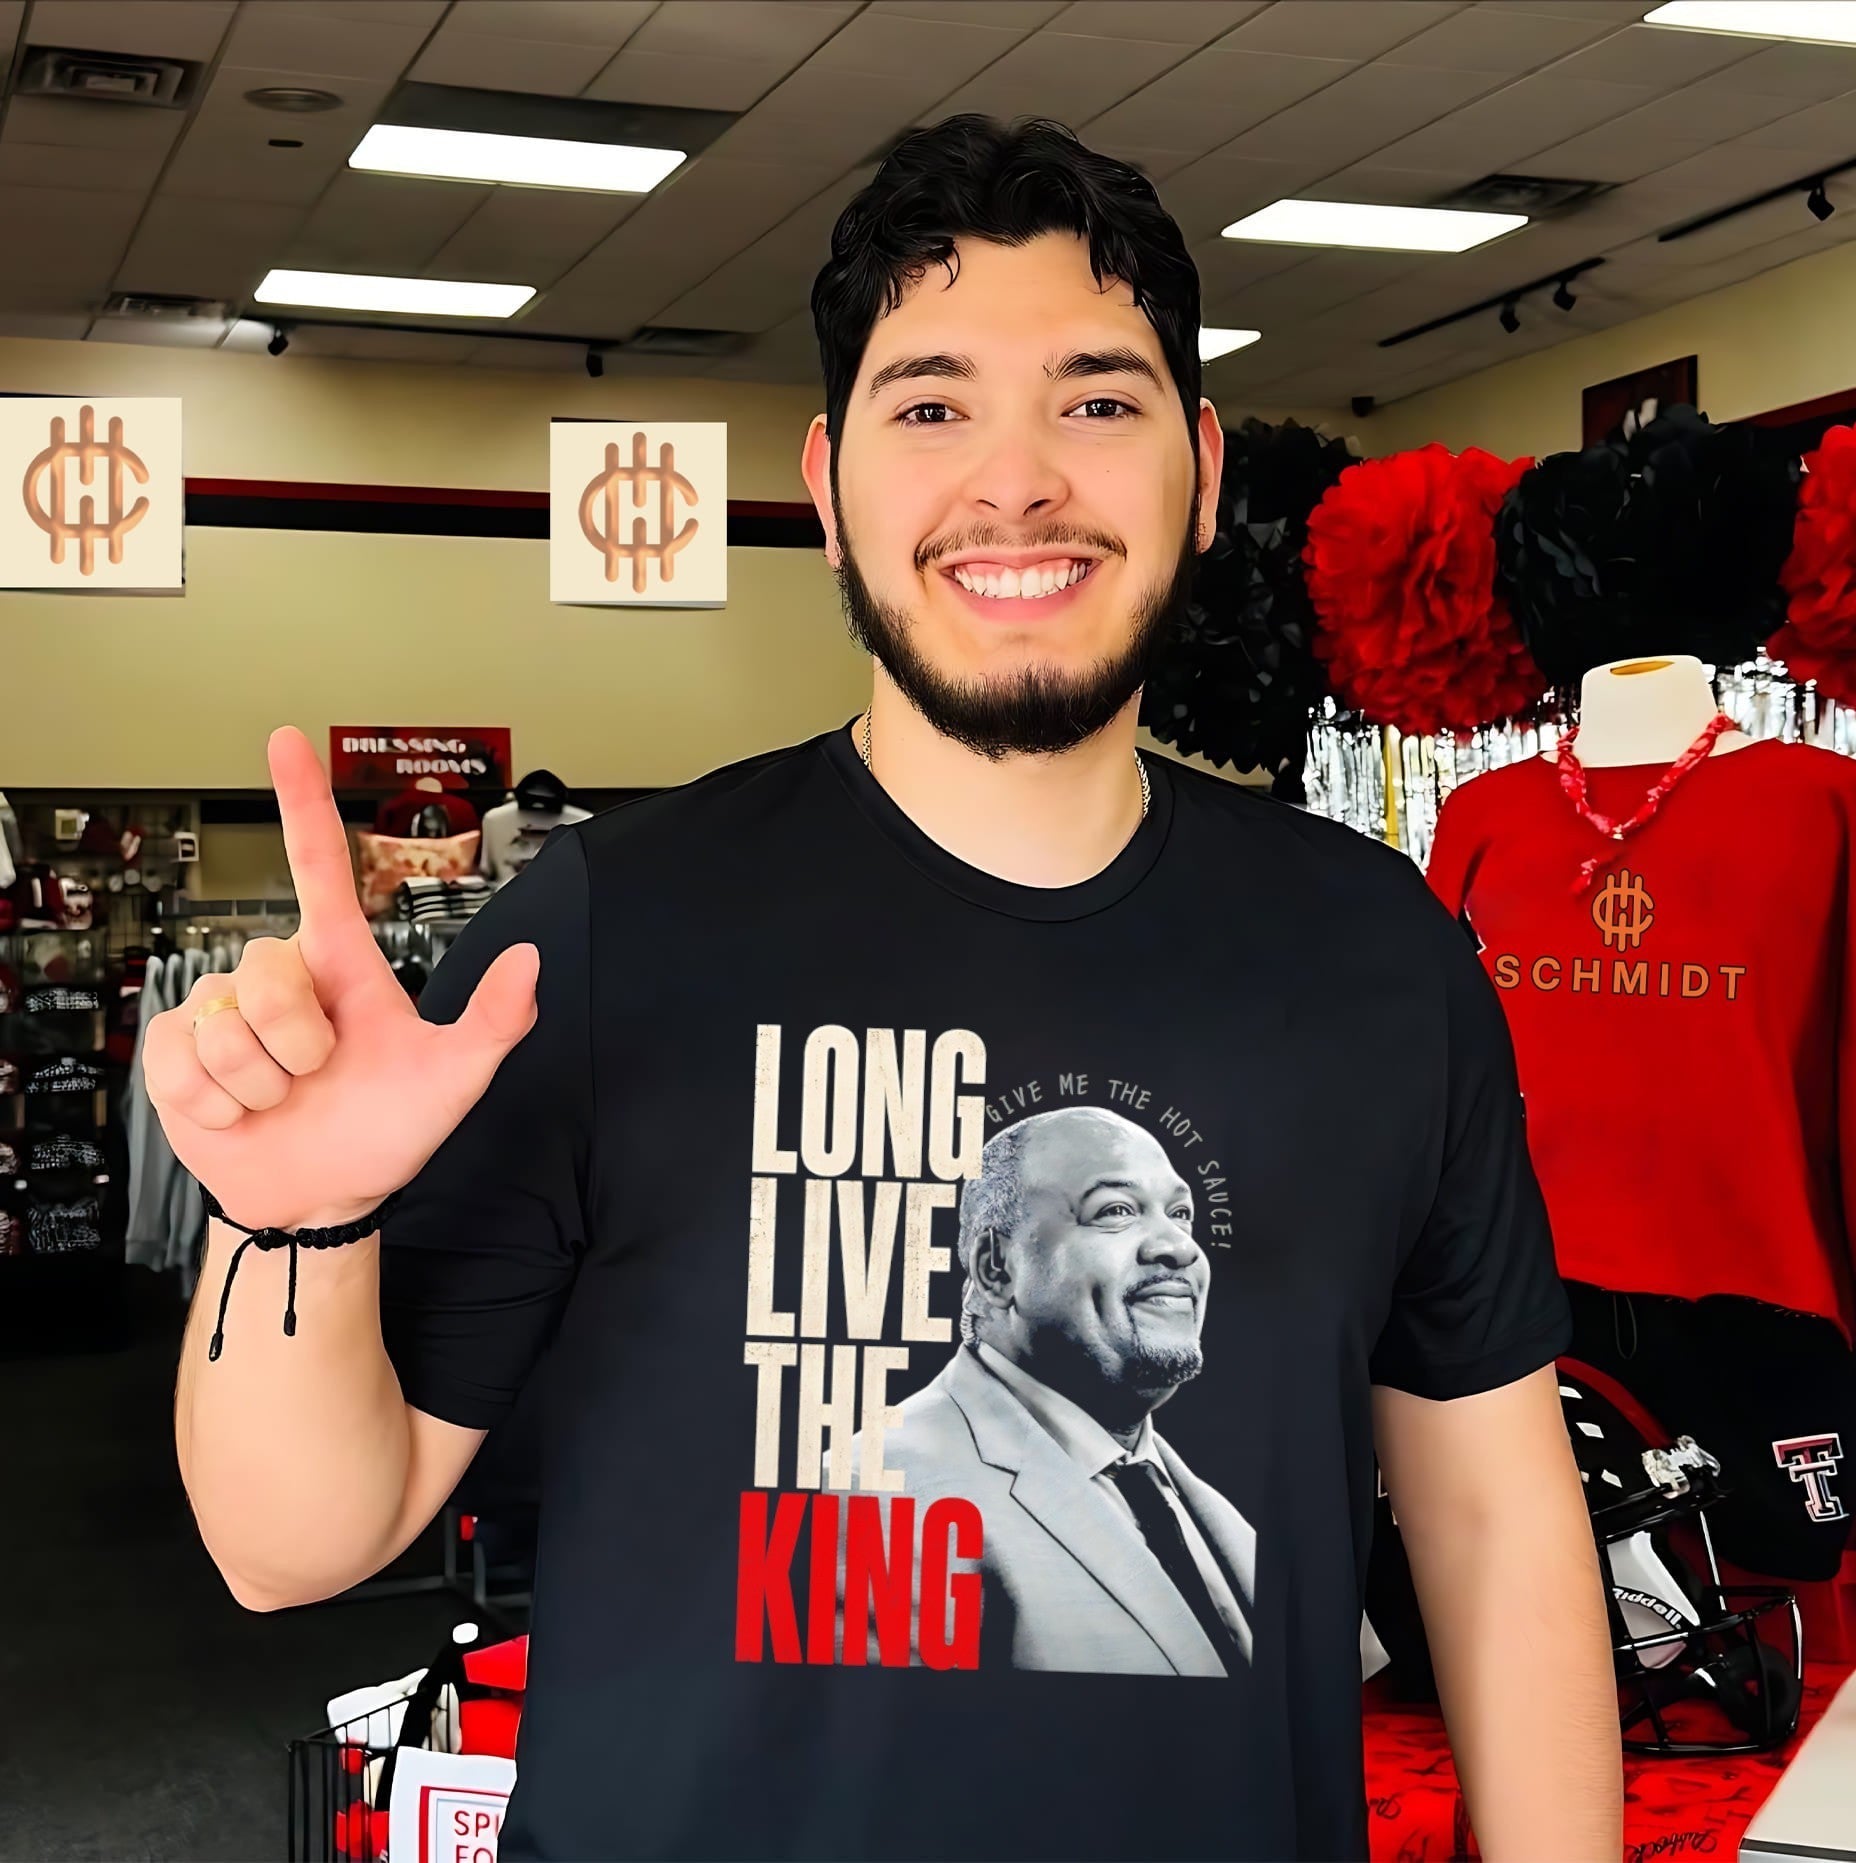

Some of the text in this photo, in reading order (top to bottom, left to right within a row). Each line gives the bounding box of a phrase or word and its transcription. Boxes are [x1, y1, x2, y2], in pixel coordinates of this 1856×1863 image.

[342, 738, 466, 753] DRESSING
[396, 759, 487, 775] ROOMS
[1494, 954, 1746, 999] SCHMIDT
[752, 1024, 986, 1181] LONG
[986, 1073, 1232, 1249] GIVE ME THE HOT SAUCE!
[746, 1177, 956, 1342] LIVE
[744, 1341, 909, 1492] THE
[735, 1491, 984, 1671] KING
